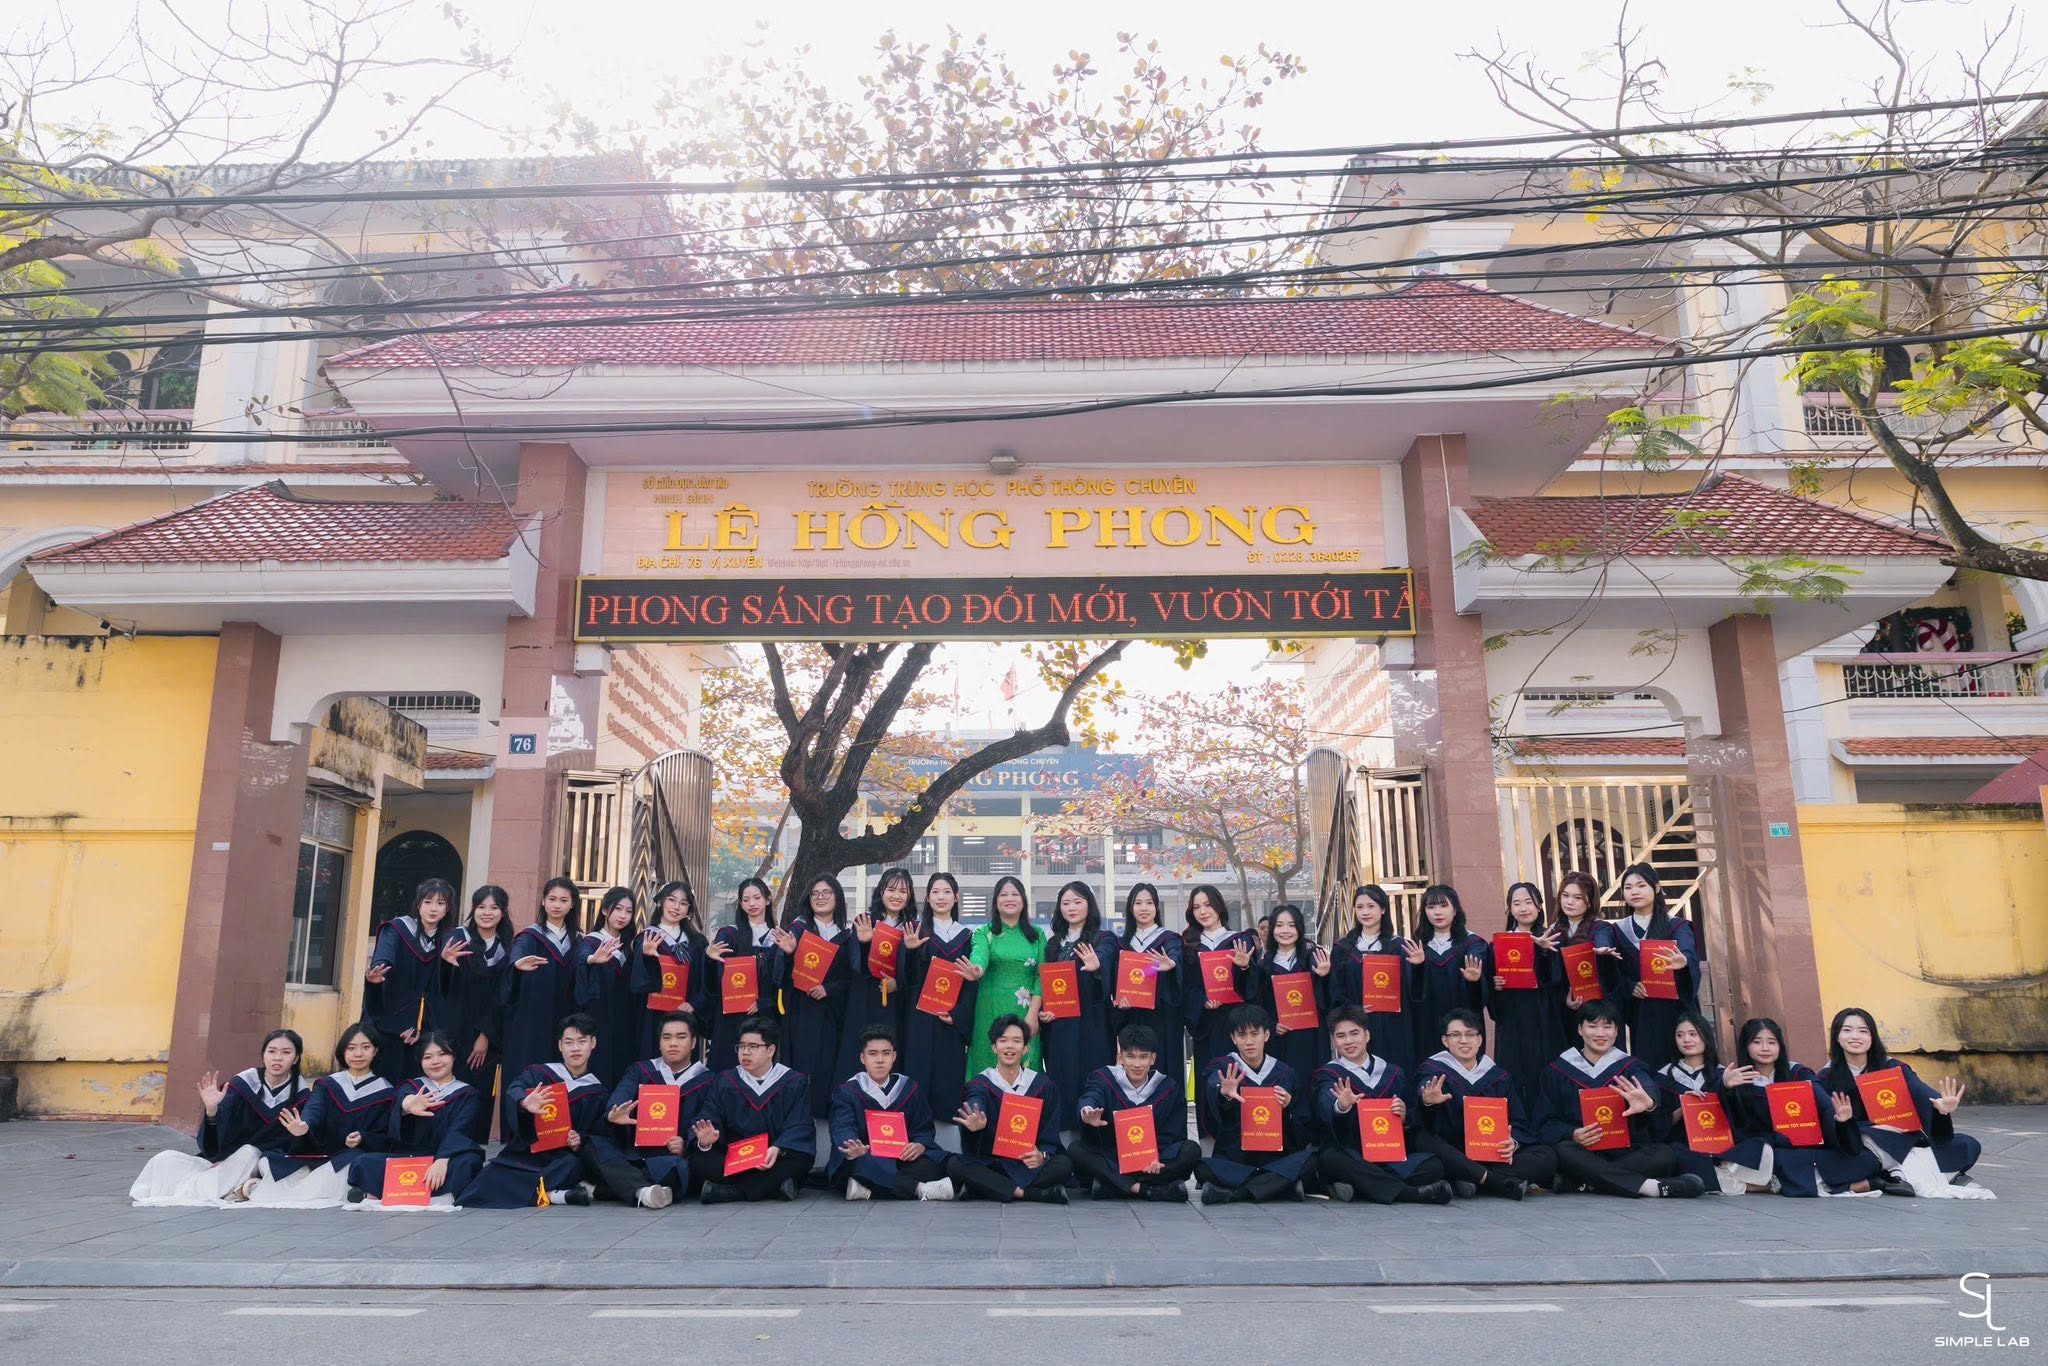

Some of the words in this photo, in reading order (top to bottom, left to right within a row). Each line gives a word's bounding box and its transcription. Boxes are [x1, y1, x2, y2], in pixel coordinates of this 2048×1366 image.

[889, 480, 947, 498] TRUNG
[953, 480, 995, 500] HỌC
[1007, 475, 1046, 496] PHỔ
[1052, 476, 1118, 496] THÔNG
[1125, 475, 1197, 494] CHUYÊN
[663, 502, 760, 551] LÊ
[792, 501, 1016, 551] HỒNG
[1044, 506, 1320, 549] PHONG
[637, 556, 657, 570] ĐỊA
[687, 556, 702, 569] 76
[710, 556, 720, 570] VỊ
[586, 594, 731, 624] PHONG
[742, 586, 855, 624] SÁNG
[866, 594, 952, 630] TẠO
[962, 586, 1037, 624] ĐỔI
[1048, 584, 1137, 628] MỚI,
[1150, 586, 1273, 622] VƯƠN
[1284, 580, 1354, 620] TỚI
[514, 737, 532, 752] 76
